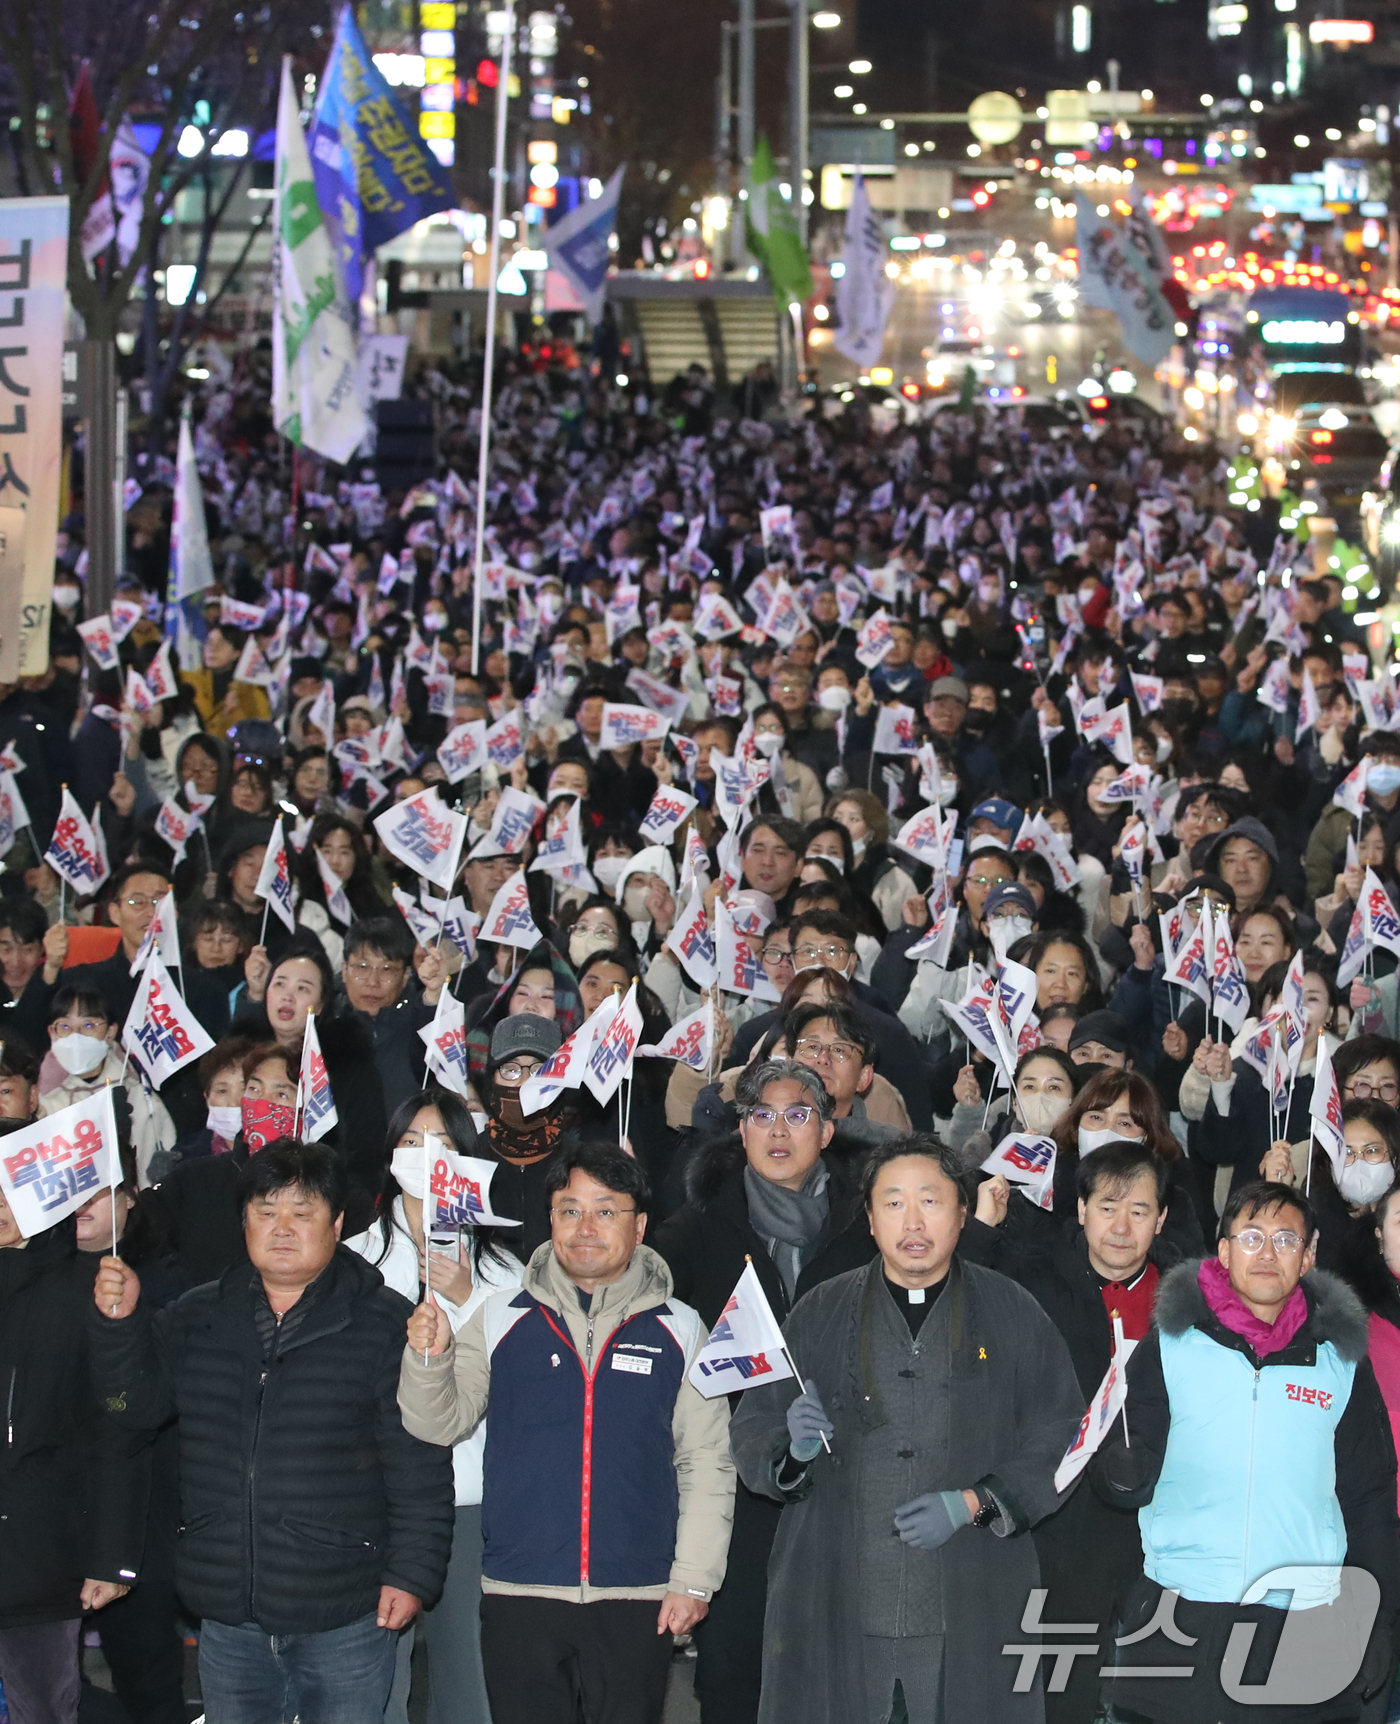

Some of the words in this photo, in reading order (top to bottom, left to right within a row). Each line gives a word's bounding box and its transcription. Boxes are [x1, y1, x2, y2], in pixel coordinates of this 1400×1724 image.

[429, 1159, 485, 1214] 윤석열
[436, 1197, 483, 1226] 퇴진
[1285, 1383, 1333, 1411] 진보당
